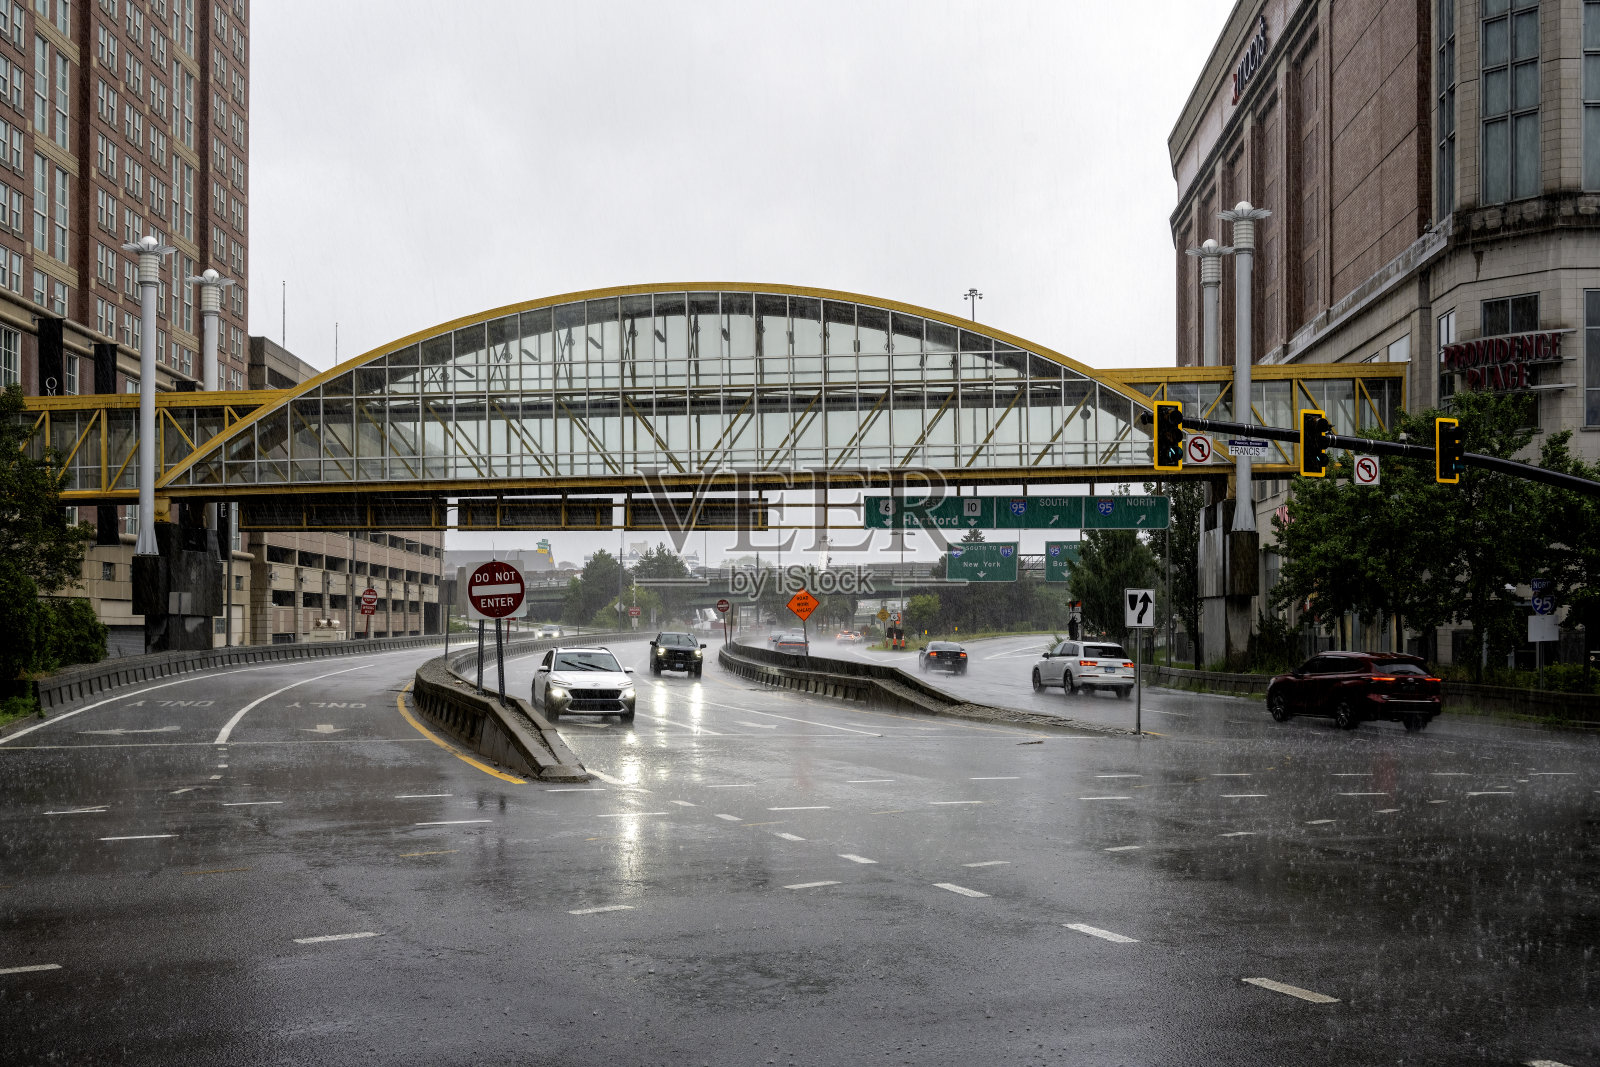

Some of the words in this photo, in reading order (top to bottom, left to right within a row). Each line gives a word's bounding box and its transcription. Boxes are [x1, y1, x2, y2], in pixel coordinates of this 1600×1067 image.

[1443, 332, 1562, 370] PROVIDENCE
[1230, 446, 1260, 456] FRANCIS
[884, 502, 890, 512] 6
[967, 502, 977, 512] 10
[1011, 503, 1026, 513] 95
[1039, 498, 1069, 507] SOUTH
[1099, 503, 1113, 513] 95
[1126, 498, 1156, 507] NORTH
[902, 515, 959, 526] Hartford
[475, 573, 489, 583] DO
[495, 571, 516, 582] NOT
[480, 597, 514, 608] ENTER
[1533, 596, 1552, 611] 95
[285, 701, 367, 709] ONLY
